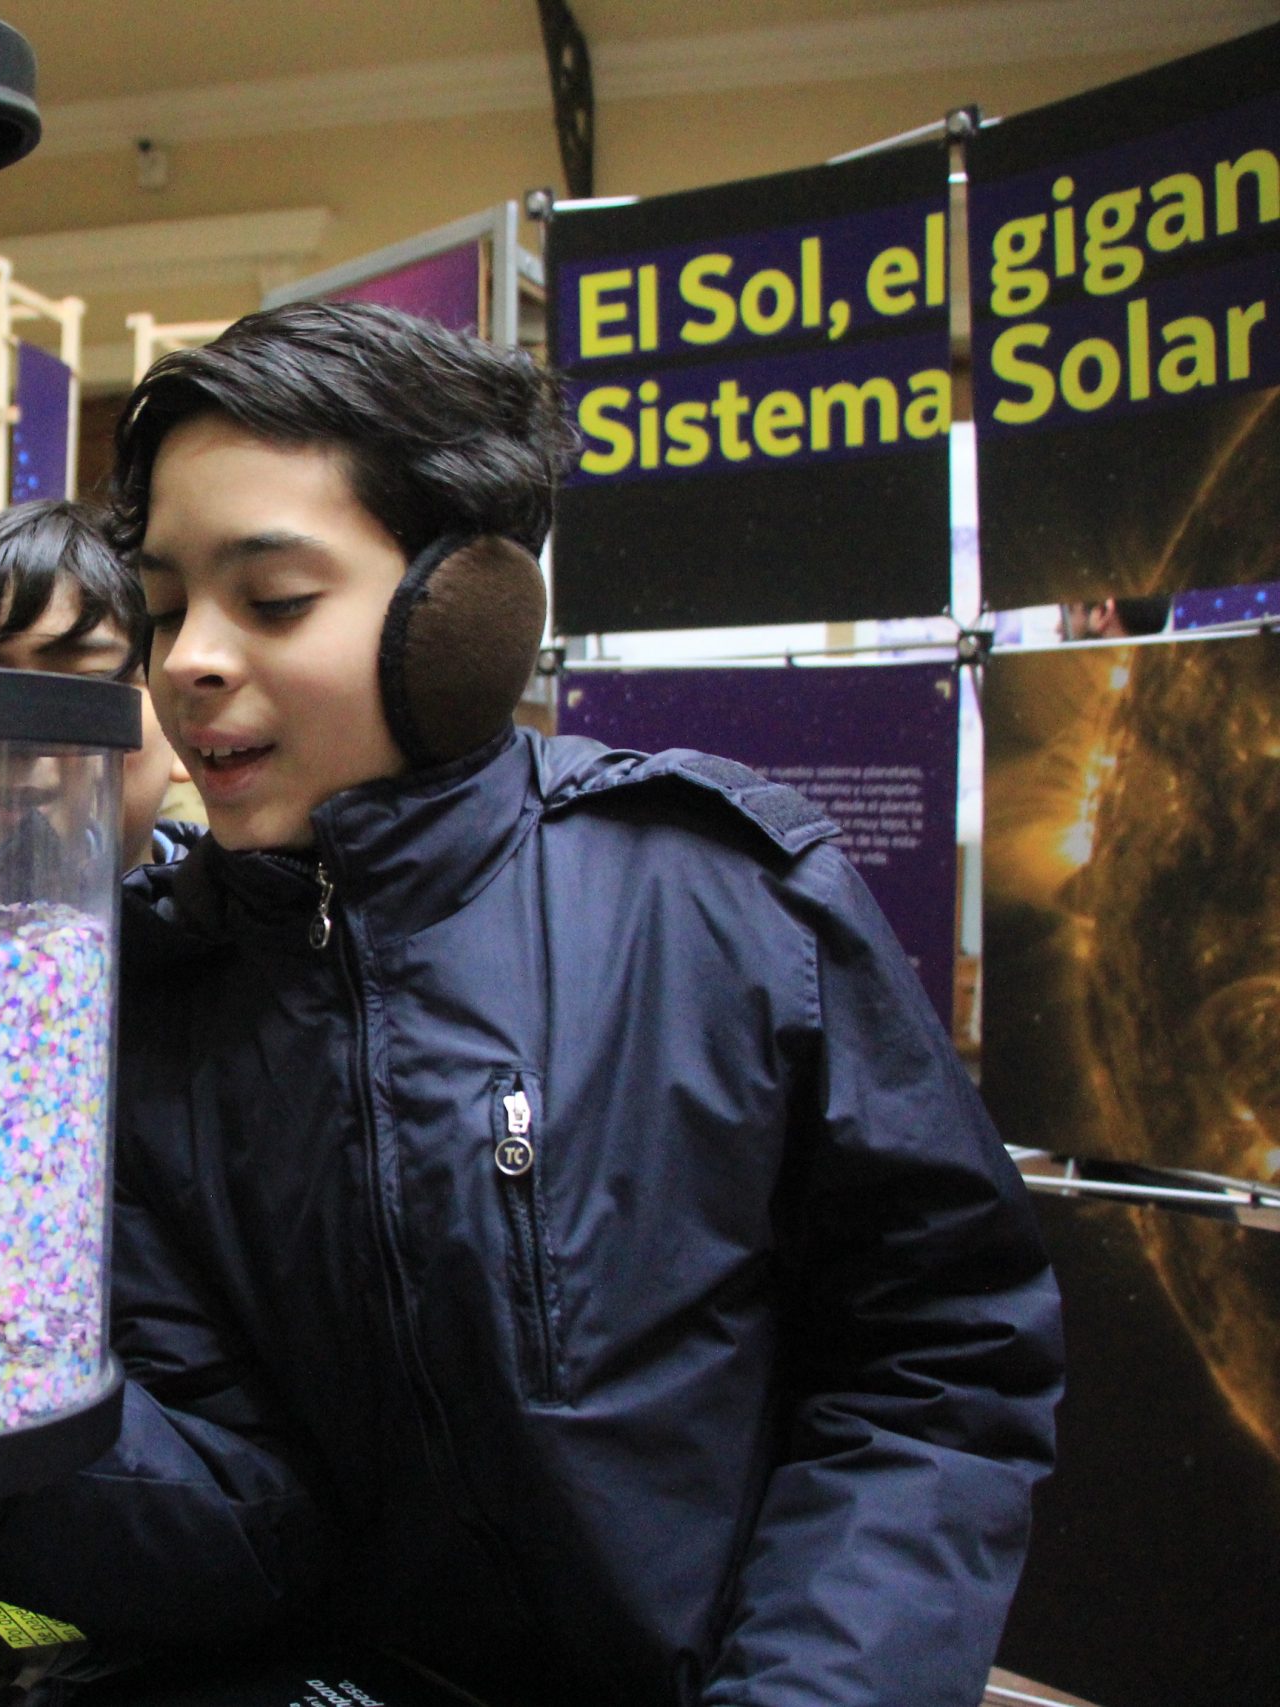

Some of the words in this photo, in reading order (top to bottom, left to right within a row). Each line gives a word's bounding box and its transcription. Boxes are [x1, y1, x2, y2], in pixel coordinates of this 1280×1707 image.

[578, 265, 658, 359] El
[678, 237, 851, 344] Sol,
[865, 211, 946, 310] el
[990, 147, 1280, 318] gigan
[577, 368, 952, 476] Sistema
[990, 298, 1266, 425] Solar
[816, 766, 861, 779] sistema
[863, 766, 924, 780] planetario,
[879, 801, 923, 814] planeta
[504, 1146, 524, 1166] TC
